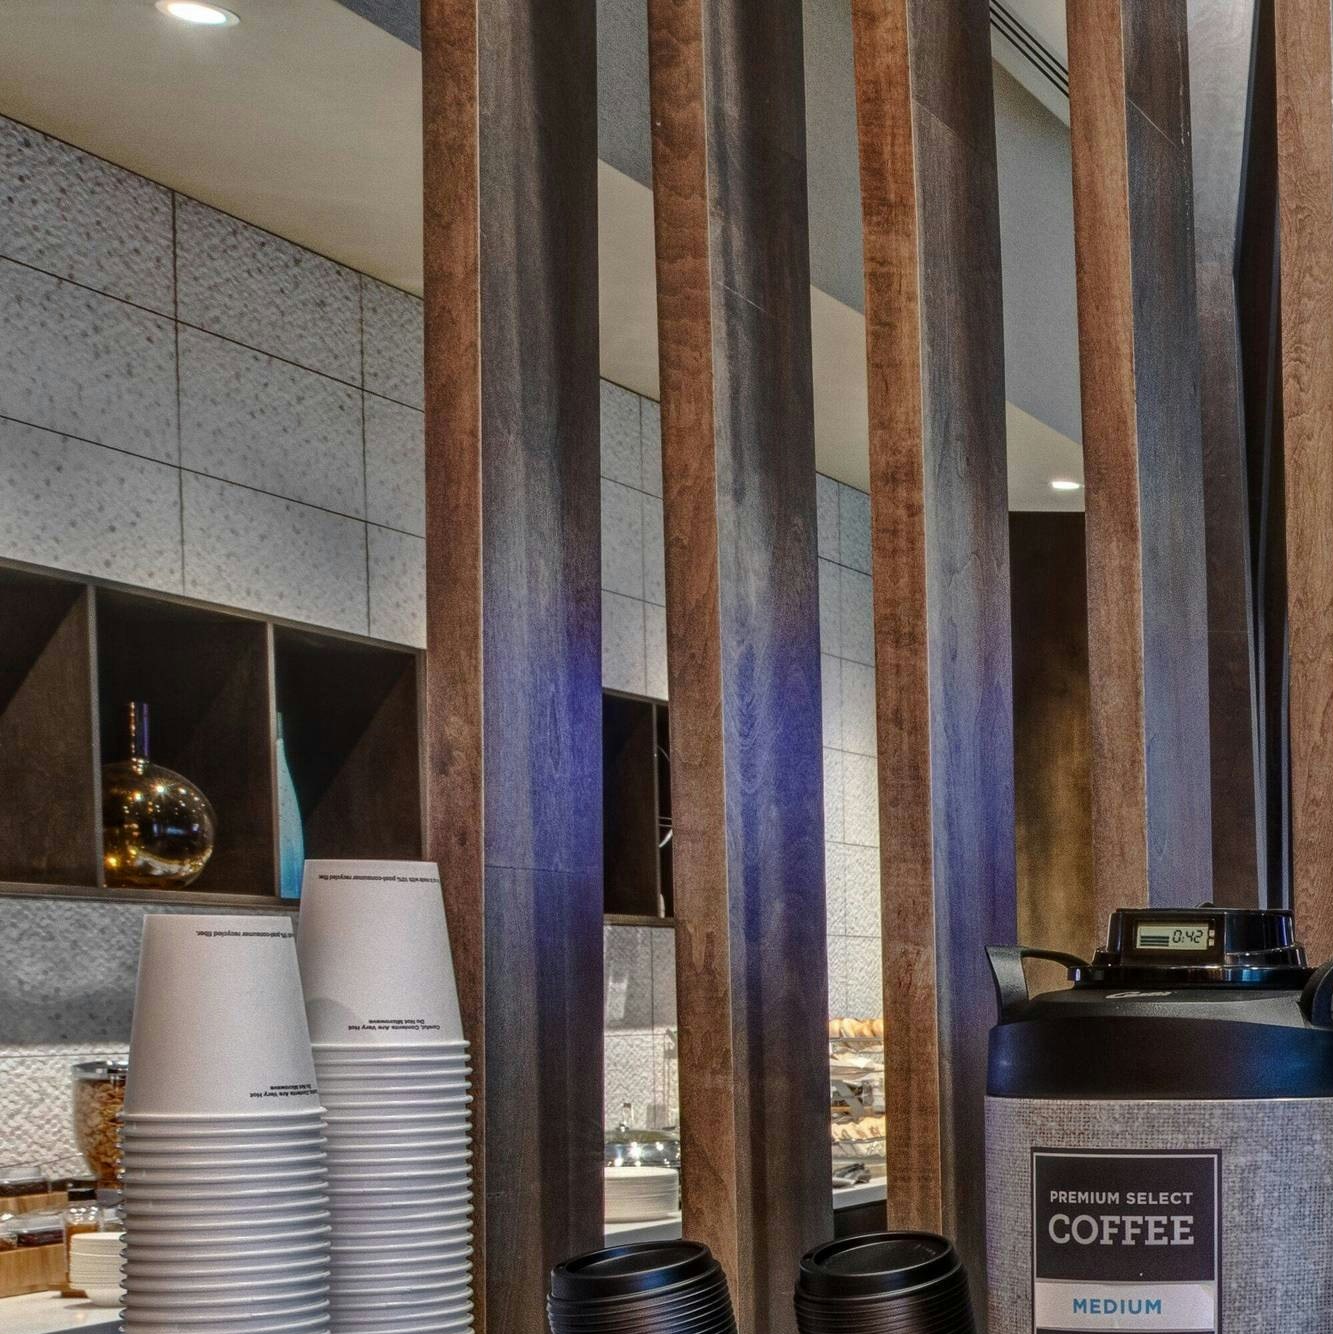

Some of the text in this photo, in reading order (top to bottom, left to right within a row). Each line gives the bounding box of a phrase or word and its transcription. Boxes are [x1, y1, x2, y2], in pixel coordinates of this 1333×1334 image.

[1172, 929, 1203, 944] 0:42
[1050, 1190, 1194, 1205] PREMIUM SELECT
[1048, 1213, 1195, 1246] COFFEE
[1073, 1298, 1162, 1314] MEDIUM
